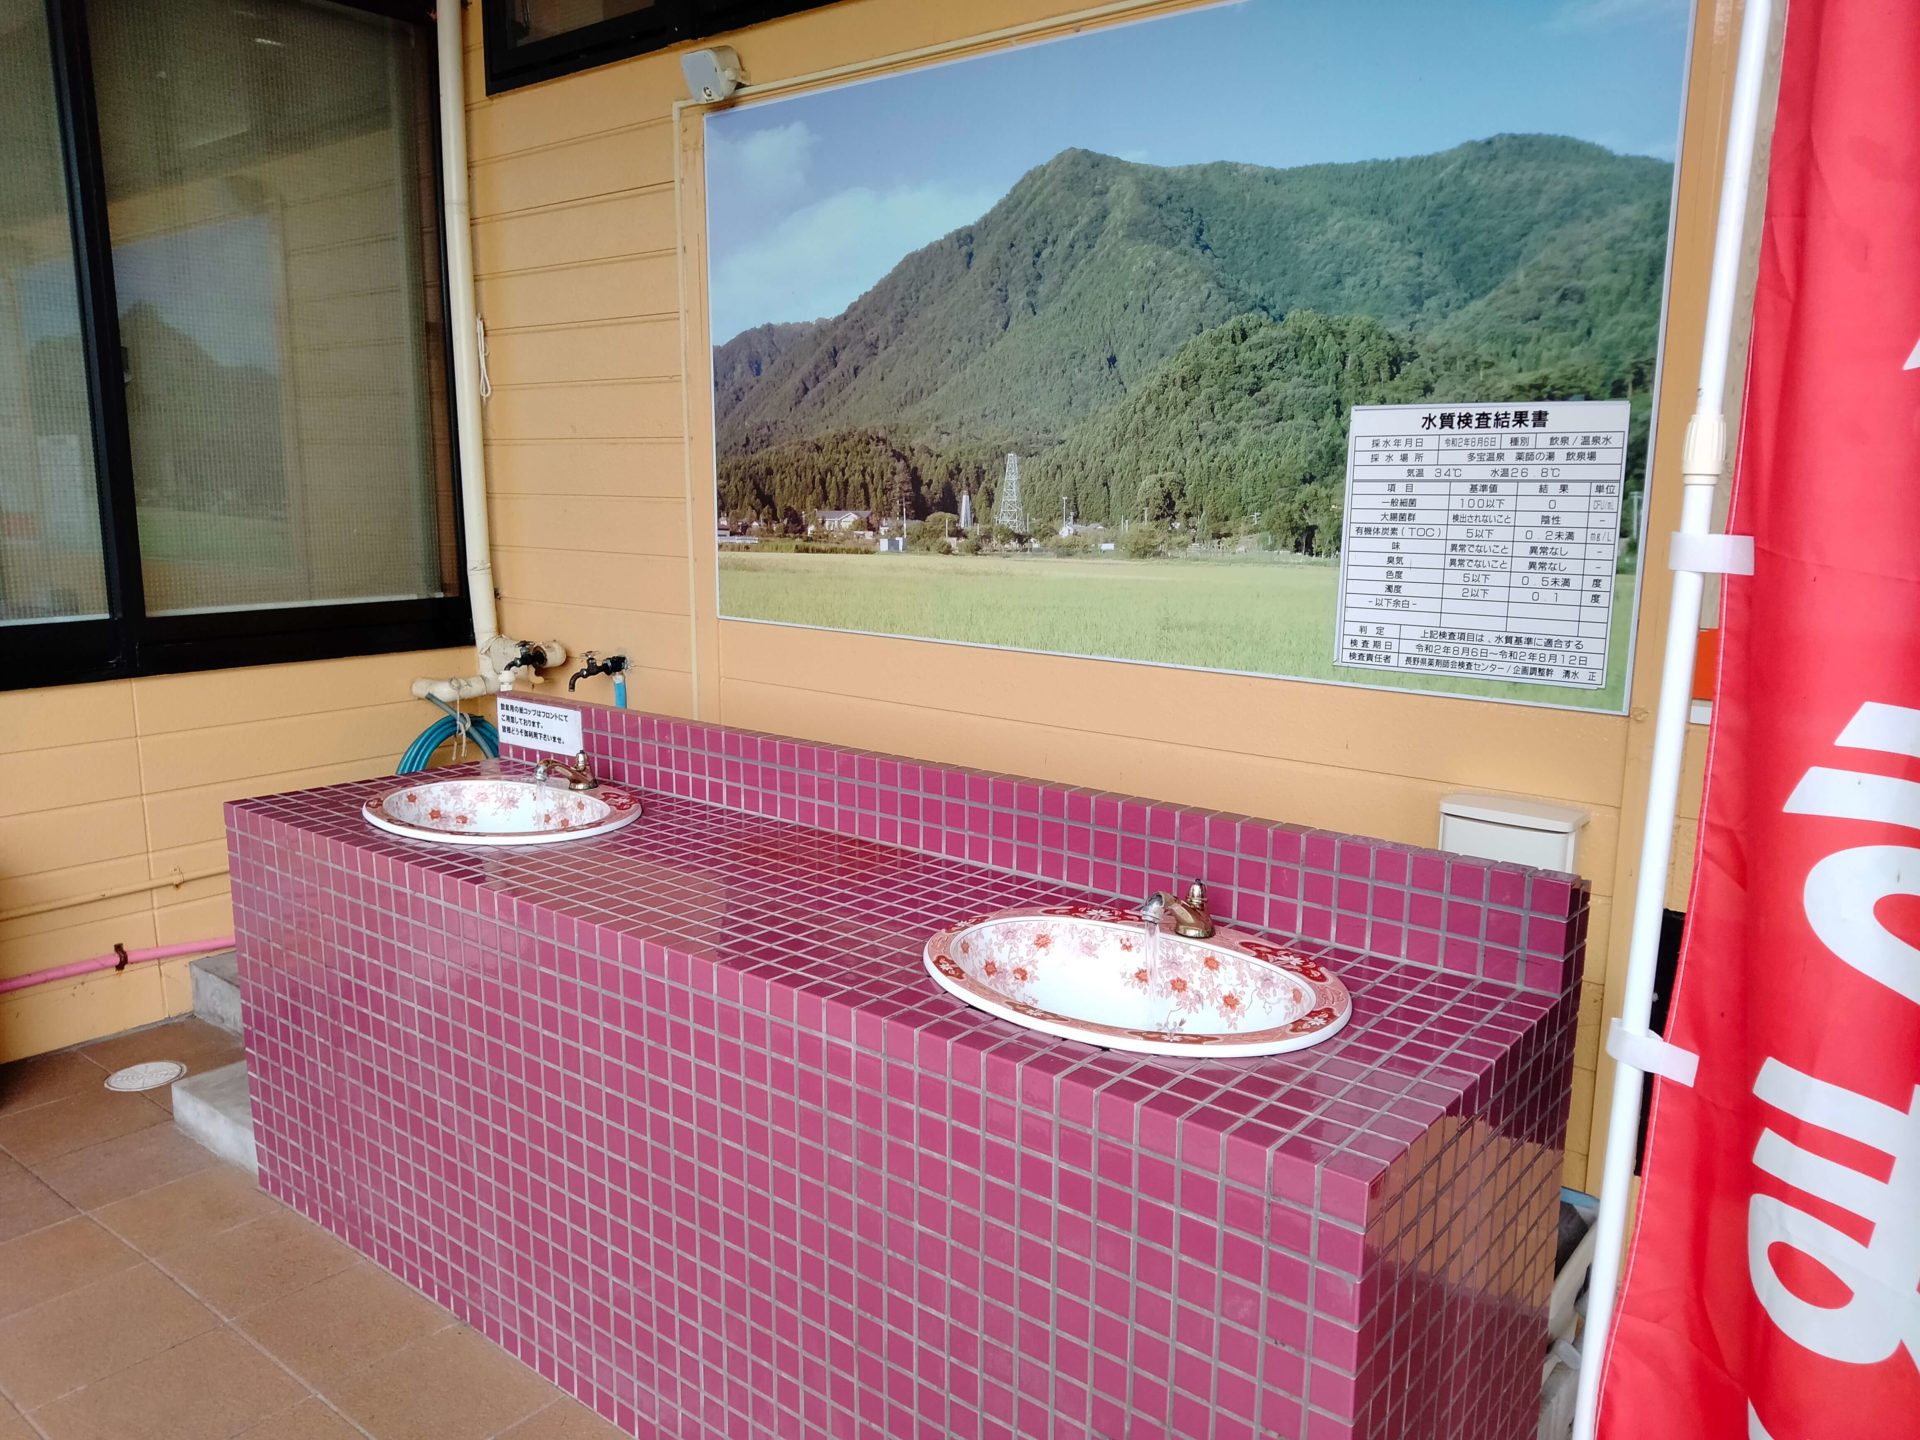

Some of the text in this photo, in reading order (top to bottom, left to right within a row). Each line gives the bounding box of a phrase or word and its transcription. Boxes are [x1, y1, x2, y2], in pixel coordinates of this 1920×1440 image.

[1421, 410, 1550, 430] 水質検査結果書
[1371, 437, 1424, 448] 採水年月日
[1444, 436, 1497, 448] 令和2年8月6日
[1509, 437, 1530, 447] 種別
[1370, 451, 1597, 463] 採水場所 多宝温泉 薬師の湯 飲泉場
[1406, 467, 1424, 478] 気温
[1434, 468, 1462, 478] 34℃
[1387, 483, 1616, 495] 項目 基準値 結果 単位
[1381, 497, 1417, 508] 一般細菌
[1459, 498, 1505, 509] 100以下
[1380, 512, 1561, 525] 大腸菌群 検出されないこと 陰性
[1466, 528, 1494, 538] 5以下
[1391, 541, 1569, 557] 味 異常でないこと 異常なし
[1386, 555, 1567, 572] 臭気 異常でないこと 異常なし
[1385, 569, 1403, 580] 色度
[1462, 573, 1491, 584] 5以下
[1592, 578, 1602, 589] 度
[1384, 584, 1402, 594] 濁度
[1461, 587, 1490, 598] 2以下
[1590, 593, 1601, 604] 度
[1359, 625, 1584, 650] 判定 上記検査項目は、水質基準に適合する
[1350, 639, 1393, 650] 検査期日
[1348, 651, 1392, 664] 検査責任者
[1562, 669, 1579, 680] 清水
[1588, 671, 1597, 682] 正
